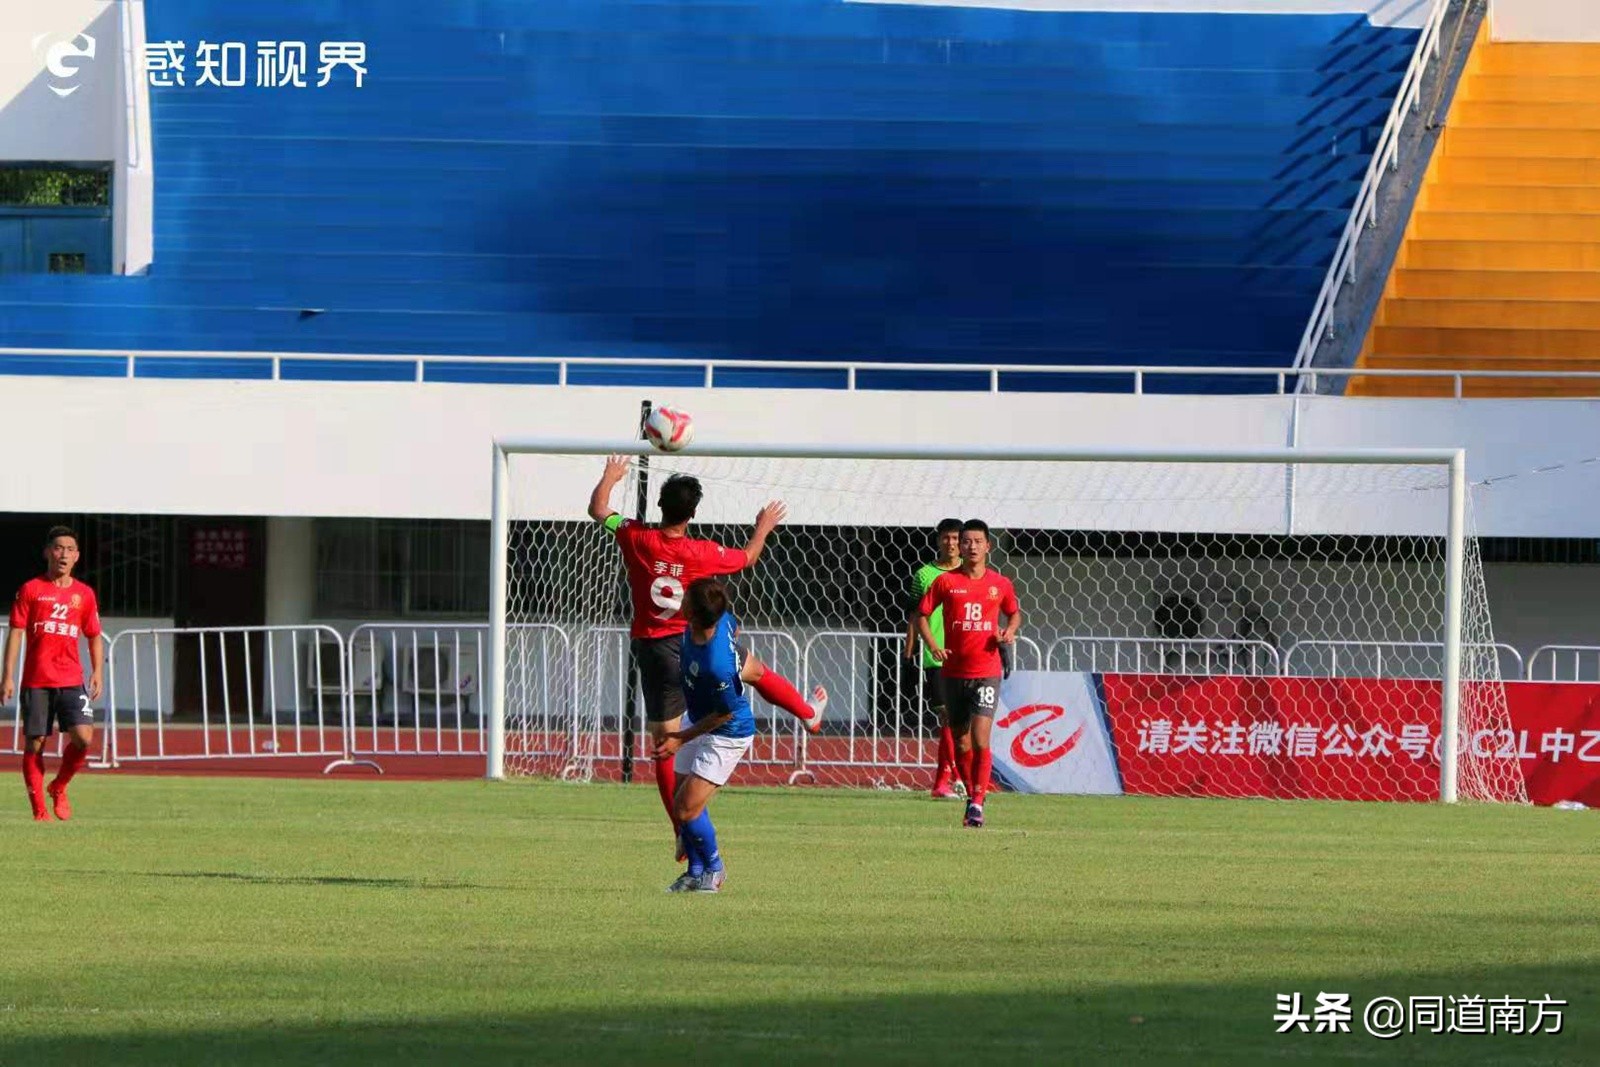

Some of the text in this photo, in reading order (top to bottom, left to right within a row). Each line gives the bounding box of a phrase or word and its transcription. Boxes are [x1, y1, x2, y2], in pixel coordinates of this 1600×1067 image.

[653, 560, 684, 577] 李菲
[650, 576, 684, 620] 9
[50, 603, 68, 620] 22
[963, 602, 982, 621] 18
[977, 686, 995, 704] 18
